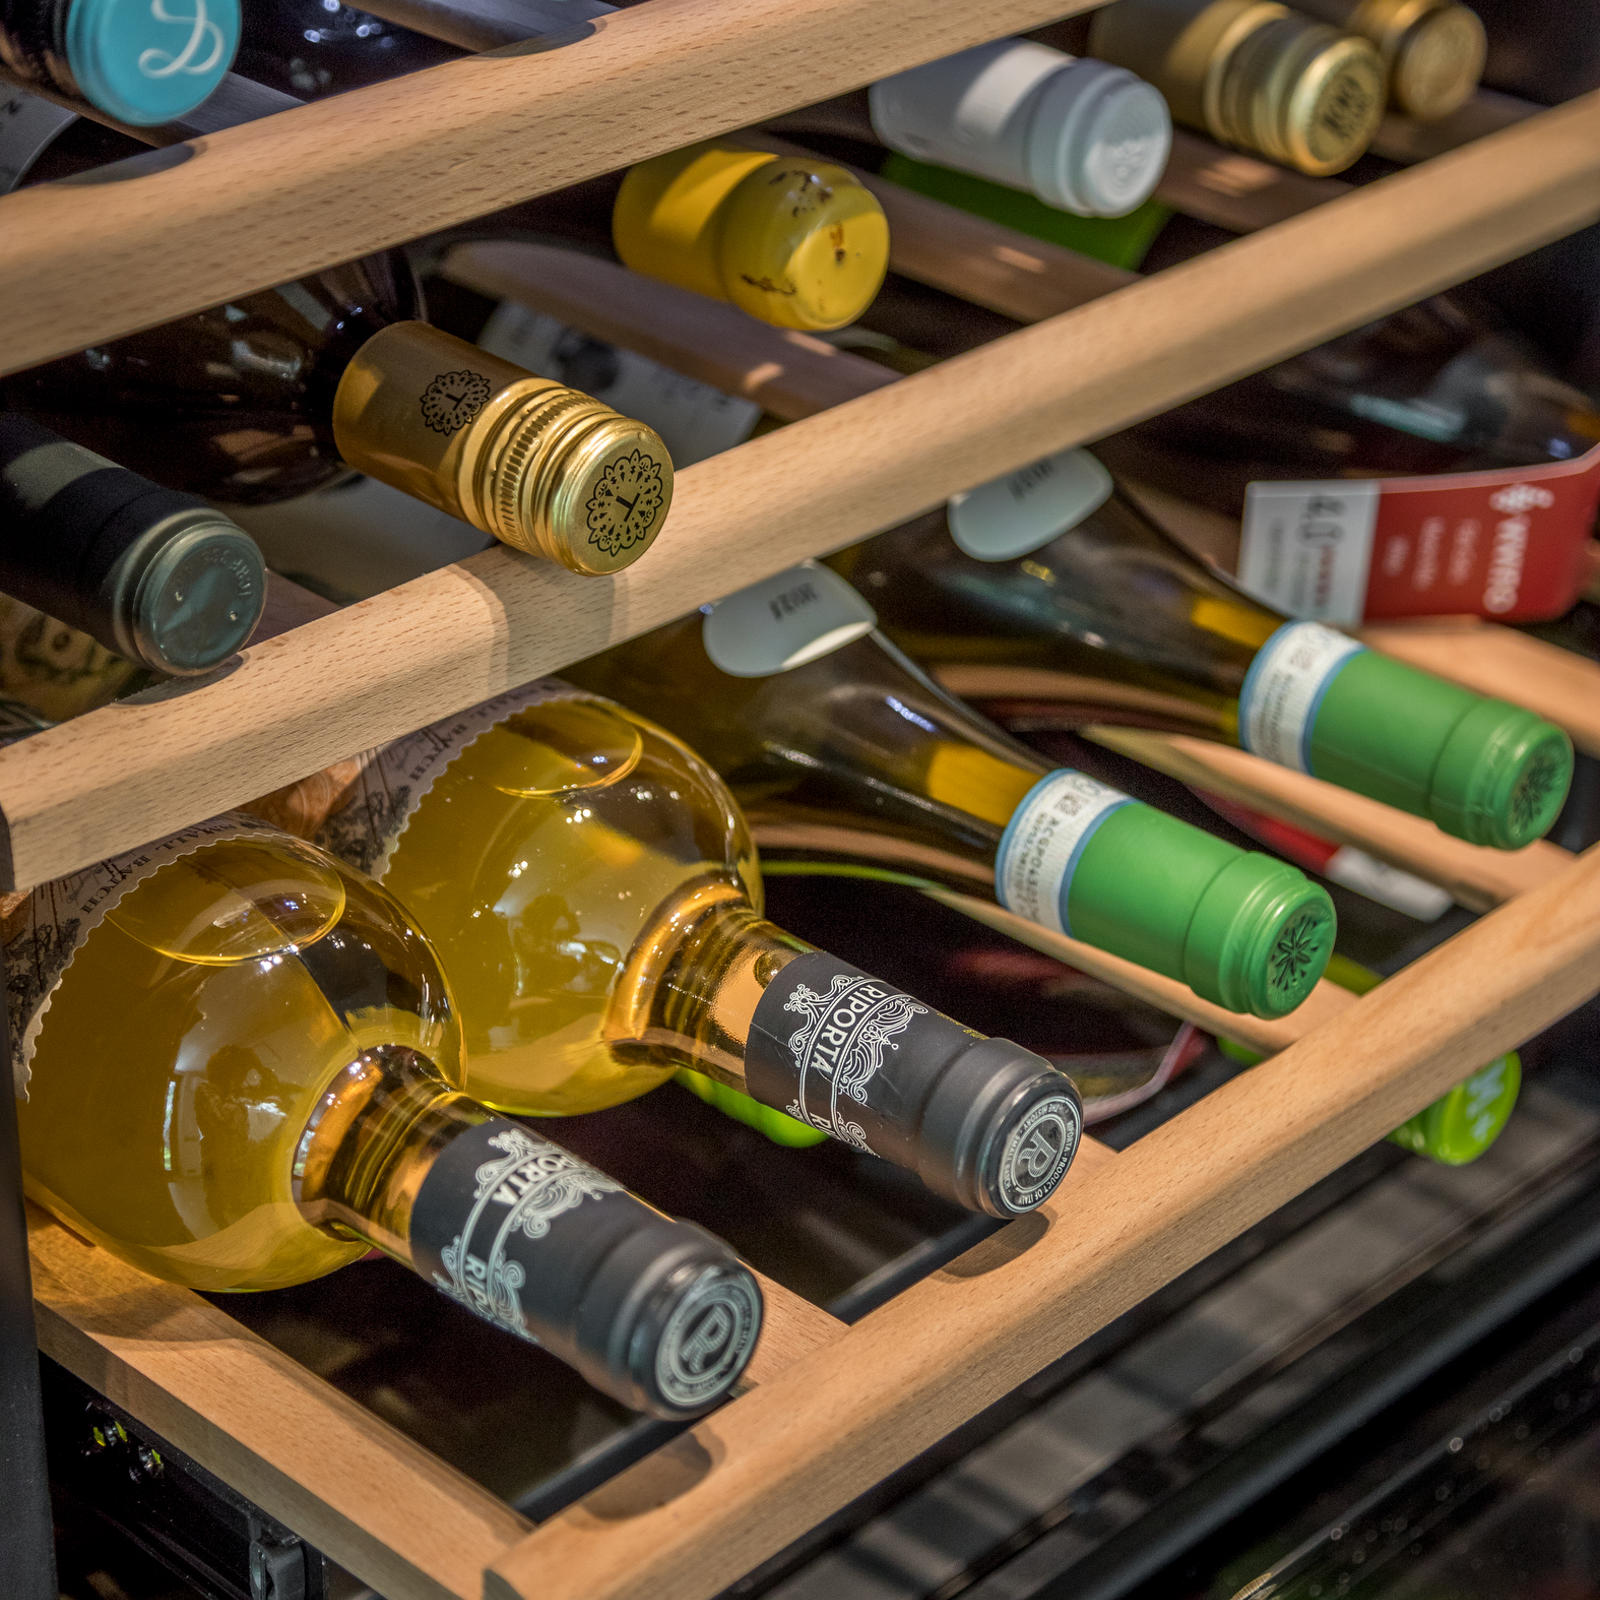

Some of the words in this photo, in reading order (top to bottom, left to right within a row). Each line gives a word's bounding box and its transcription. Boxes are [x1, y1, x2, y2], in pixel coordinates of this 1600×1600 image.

[409, 723, 467, 782] BATCH
[80, 854, 151, 914] BATCH
[811, 984, 888, 1074] RIPORTA
[1018, 1128, 1058, 1178] R
[1044, 1154, 1068, 1193] PRODUCT
[1018, 1193, 1034, 1206] ITALY
[1034, 1189, 1043, 1201] OF
[680, 1304, 731, 1374] R
